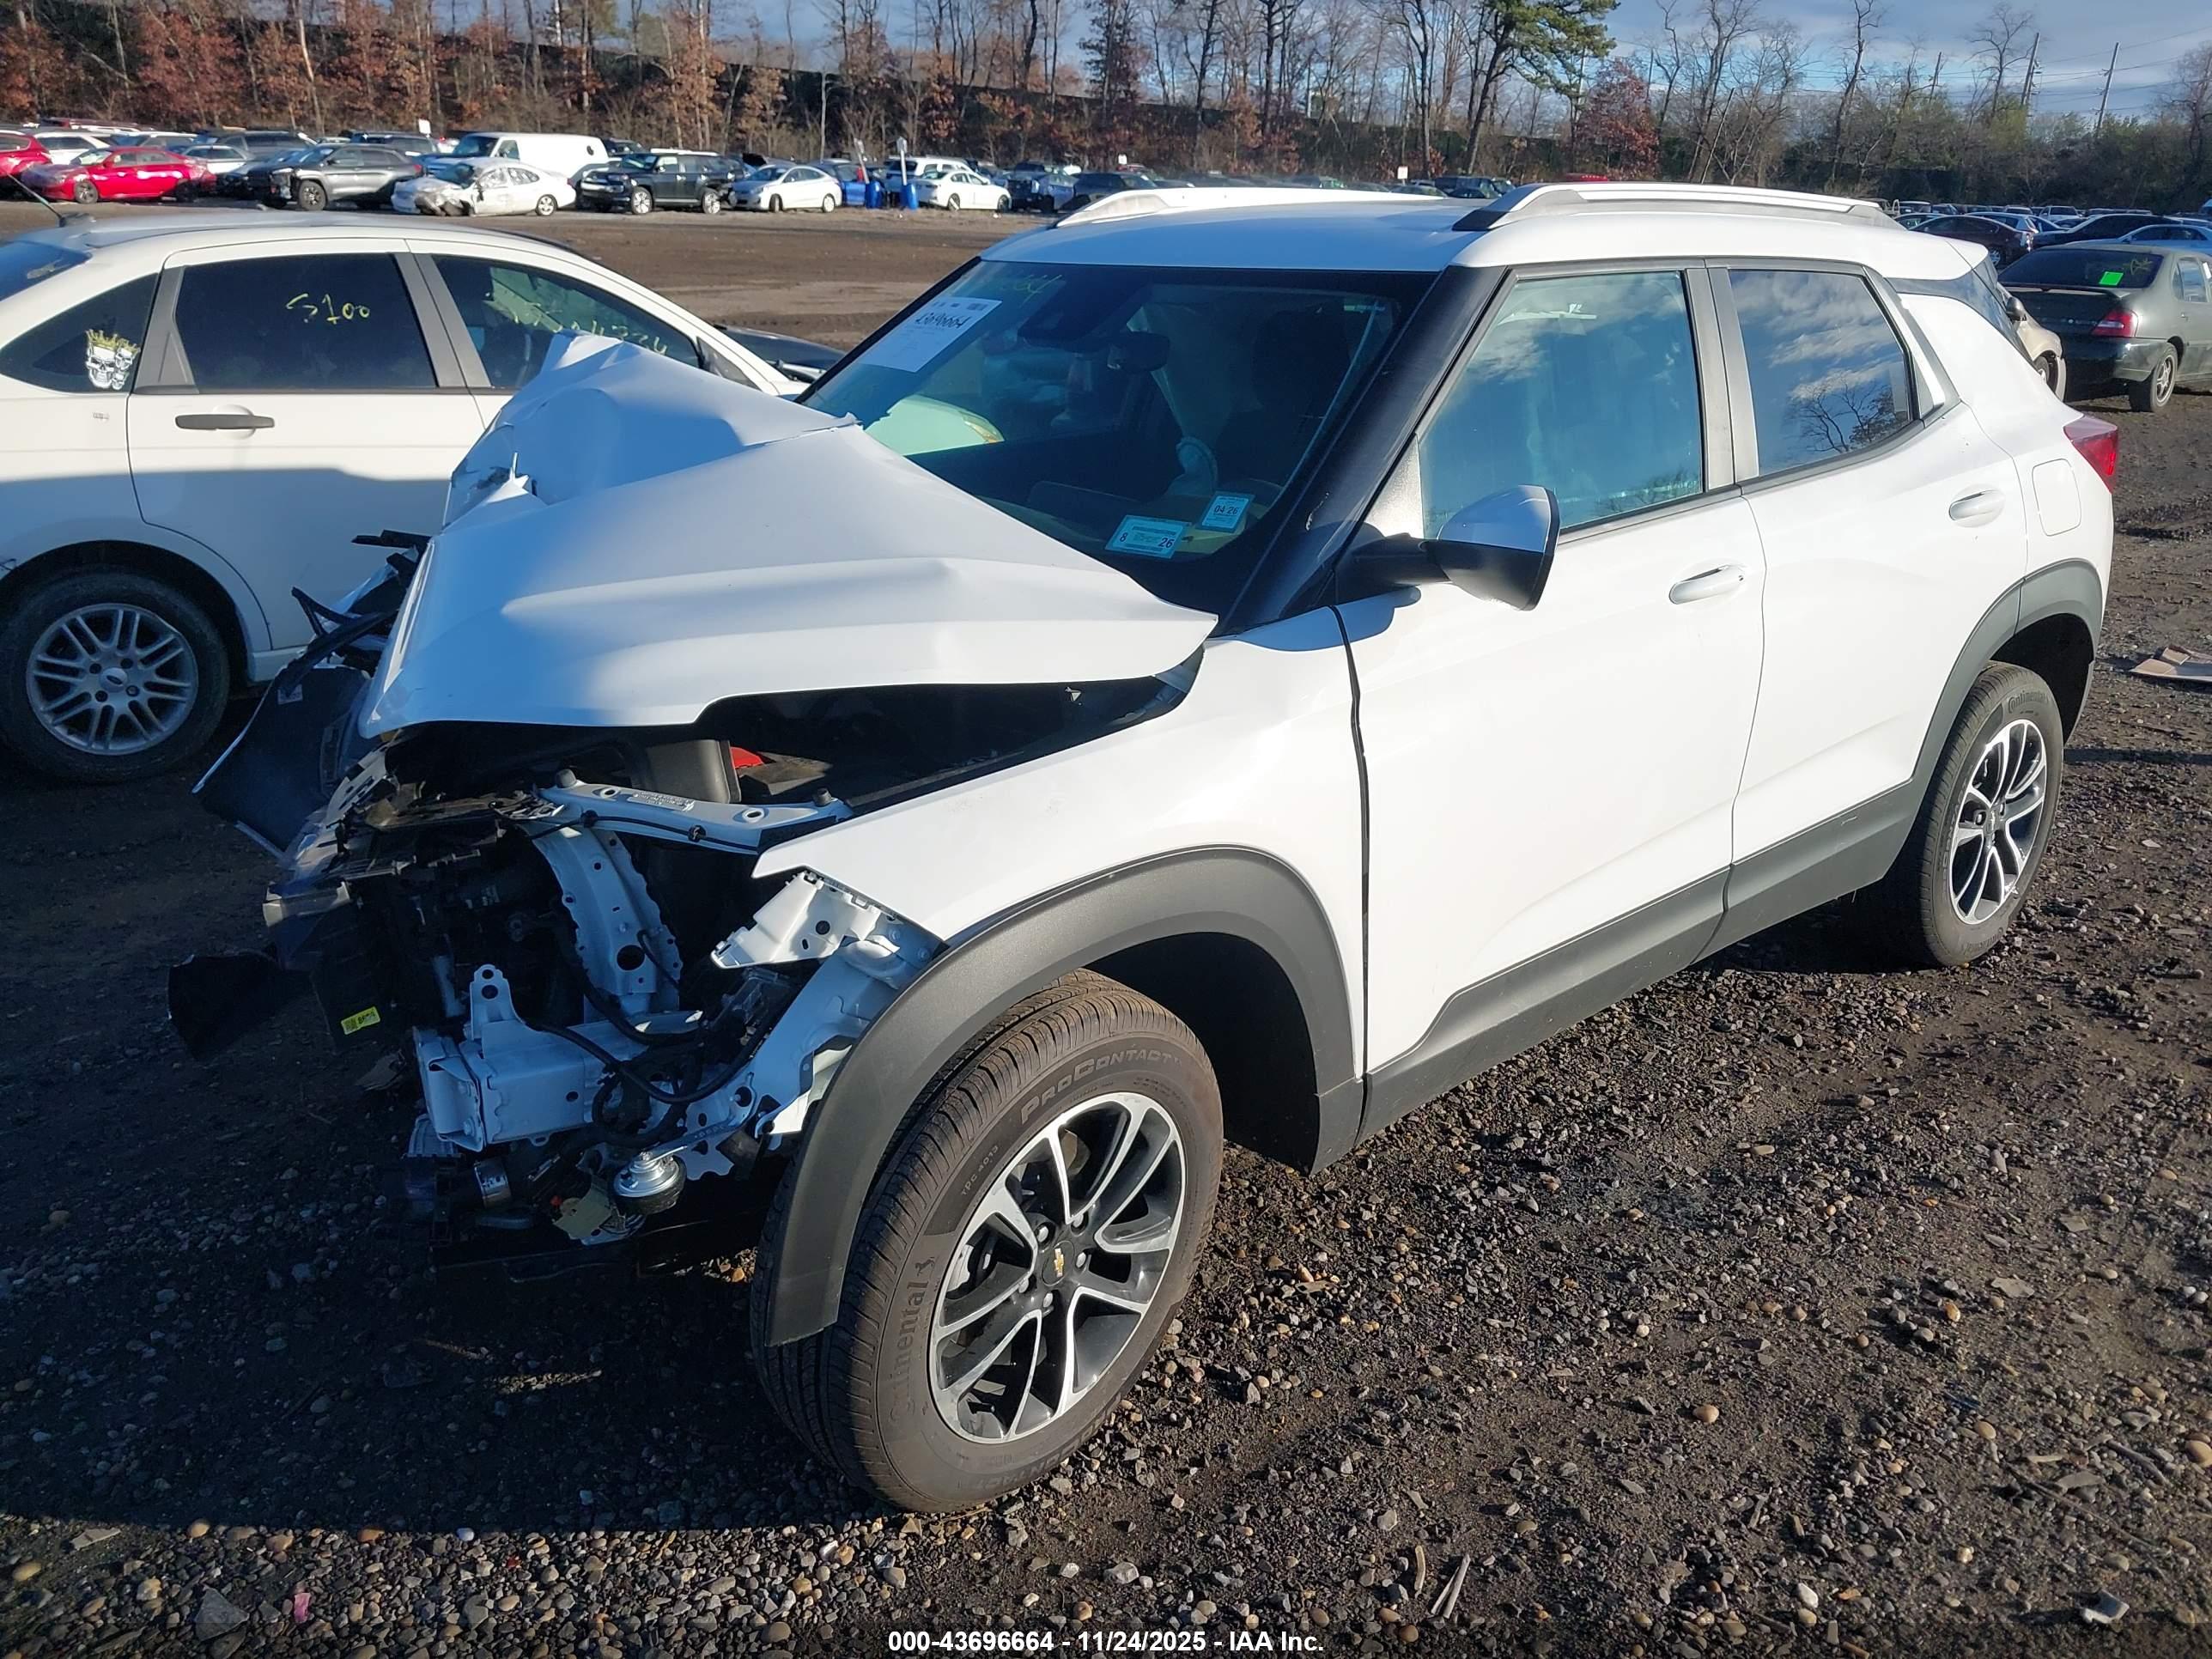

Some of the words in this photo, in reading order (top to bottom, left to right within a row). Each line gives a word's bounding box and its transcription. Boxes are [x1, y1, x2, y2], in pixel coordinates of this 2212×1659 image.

[1214, 505, 1225, 514] 04
[1227, 506, 1239, 515] 26
[1119, 532, 1128, 543] 8
[1158, 536, 1175, 549] 26
[890, 1279, 929, 1423] Cinental
